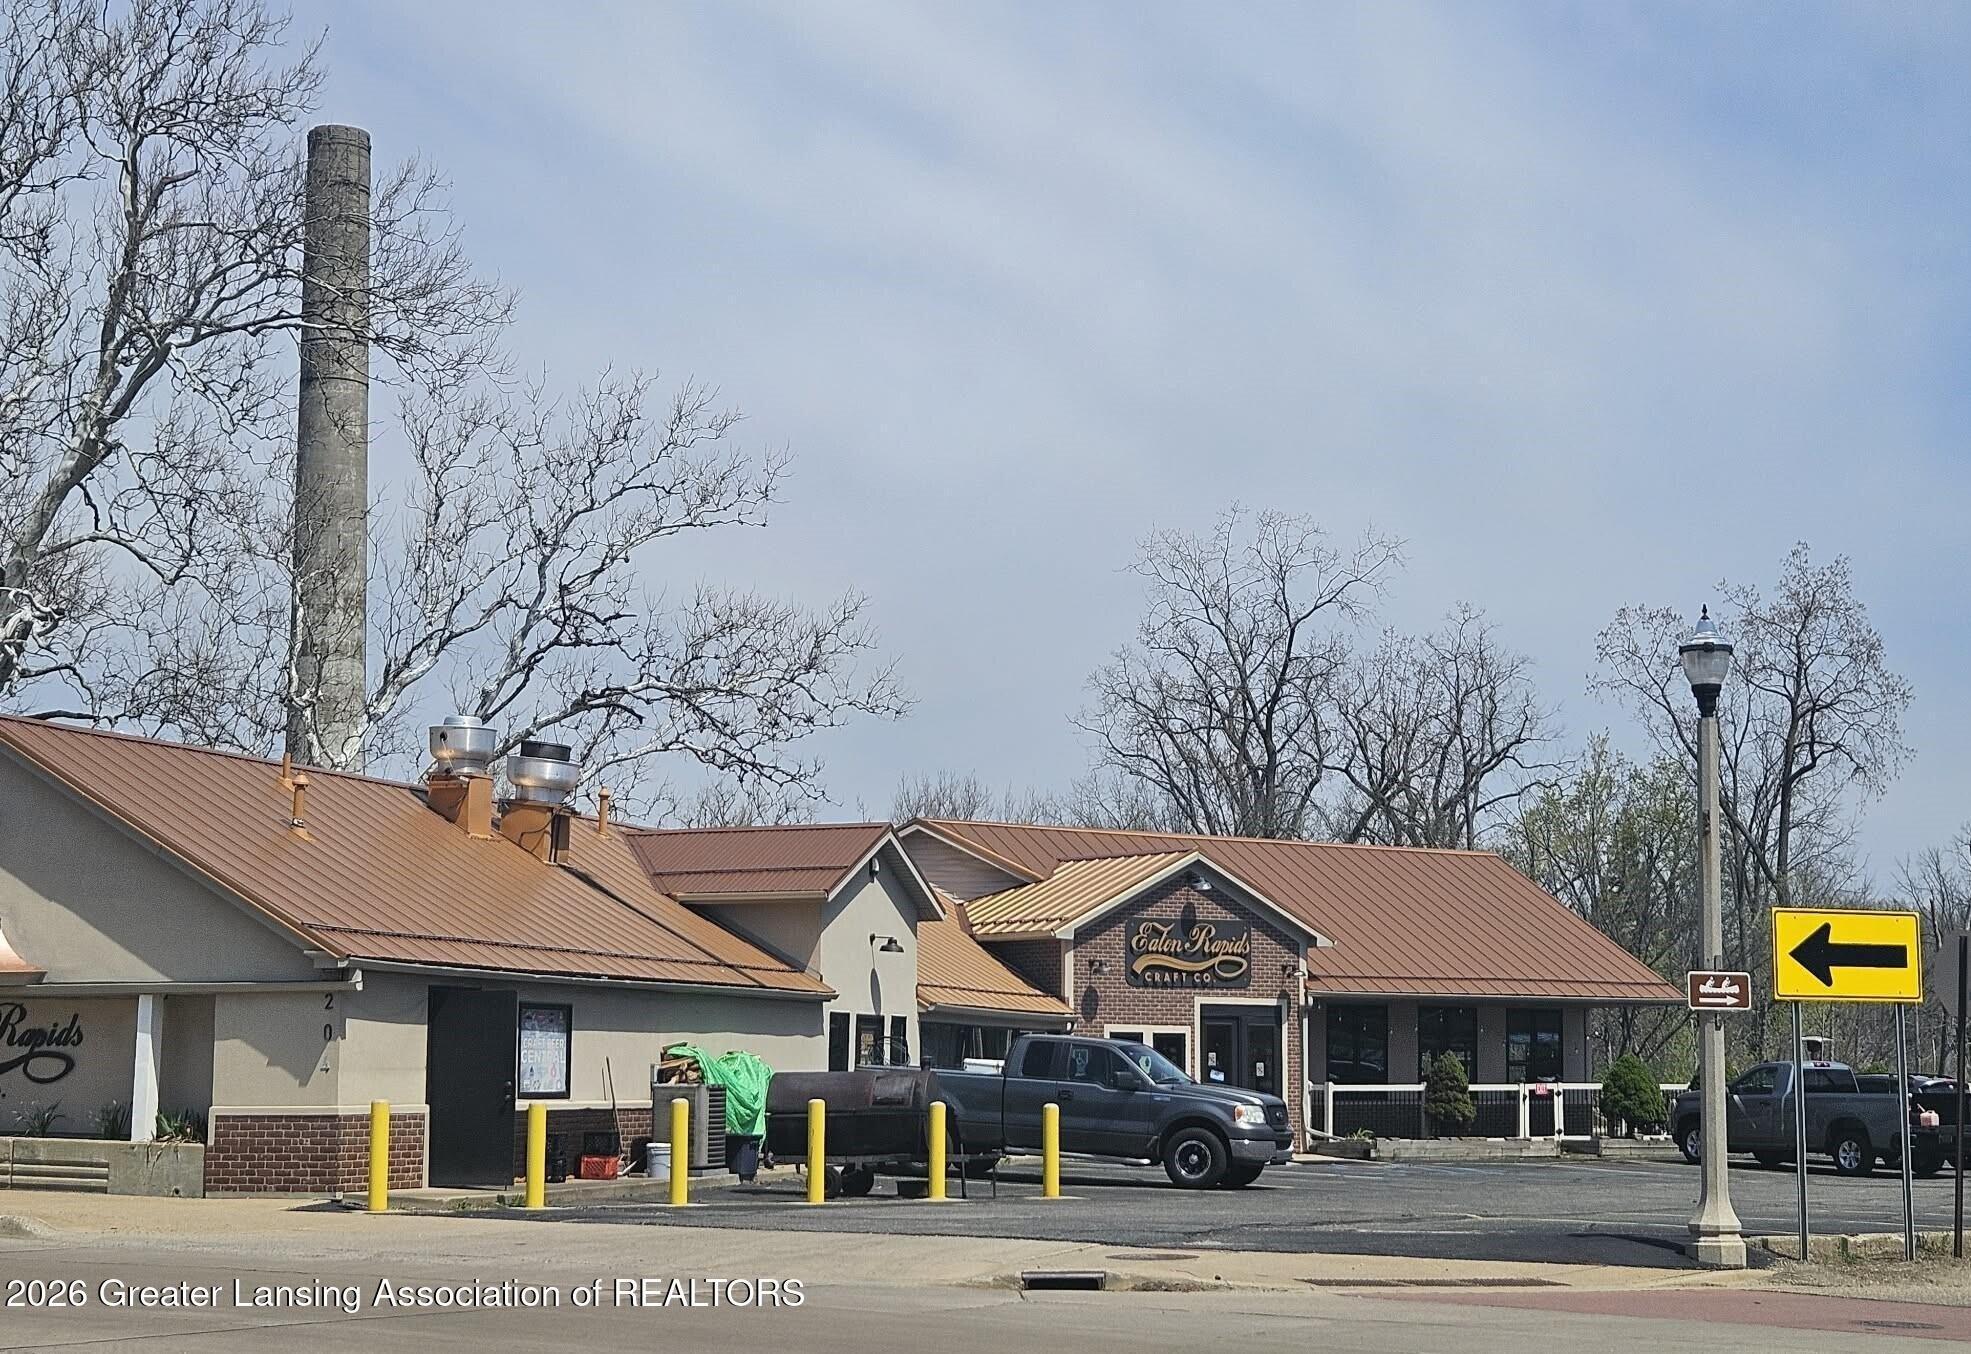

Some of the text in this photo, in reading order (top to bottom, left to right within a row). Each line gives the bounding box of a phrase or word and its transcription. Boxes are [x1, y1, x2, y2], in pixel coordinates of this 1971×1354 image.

[1131, 921, 1250, 959] Eaton Rapids
[1145, 972, 1217, 984] CRAFT CO.
[0, 1003, 83, 1055] Rapids
[521, 1049, 566, 1064] CENTRAL
